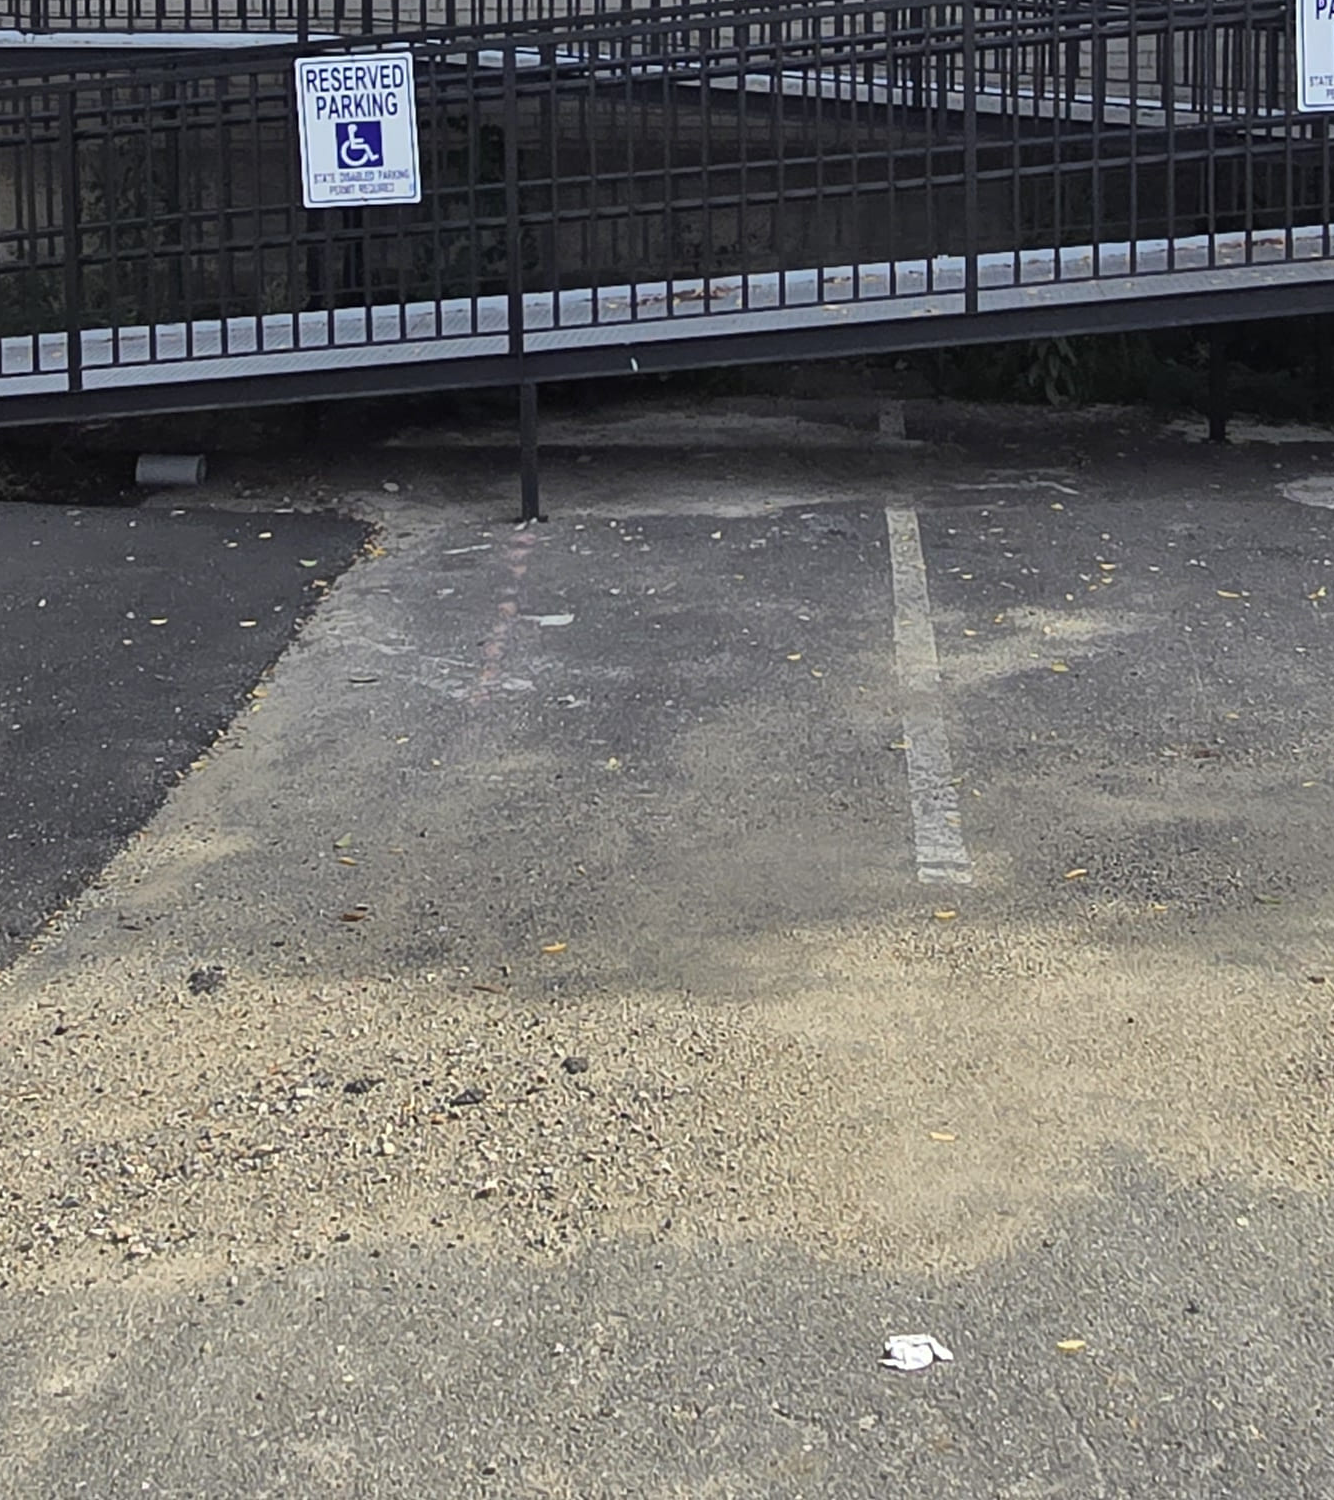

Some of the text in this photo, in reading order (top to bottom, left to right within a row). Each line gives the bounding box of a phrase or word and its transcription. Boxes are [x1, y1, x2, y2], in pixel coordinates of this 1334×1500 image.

[305, 64, 405, 93] RESERVED
[1309, 75, 1333, 87] STATE
[315, 92, 398, 120] PARKING
[313, 173, 336, 184] STATE
[378, 168, 409, 180] PARKING
